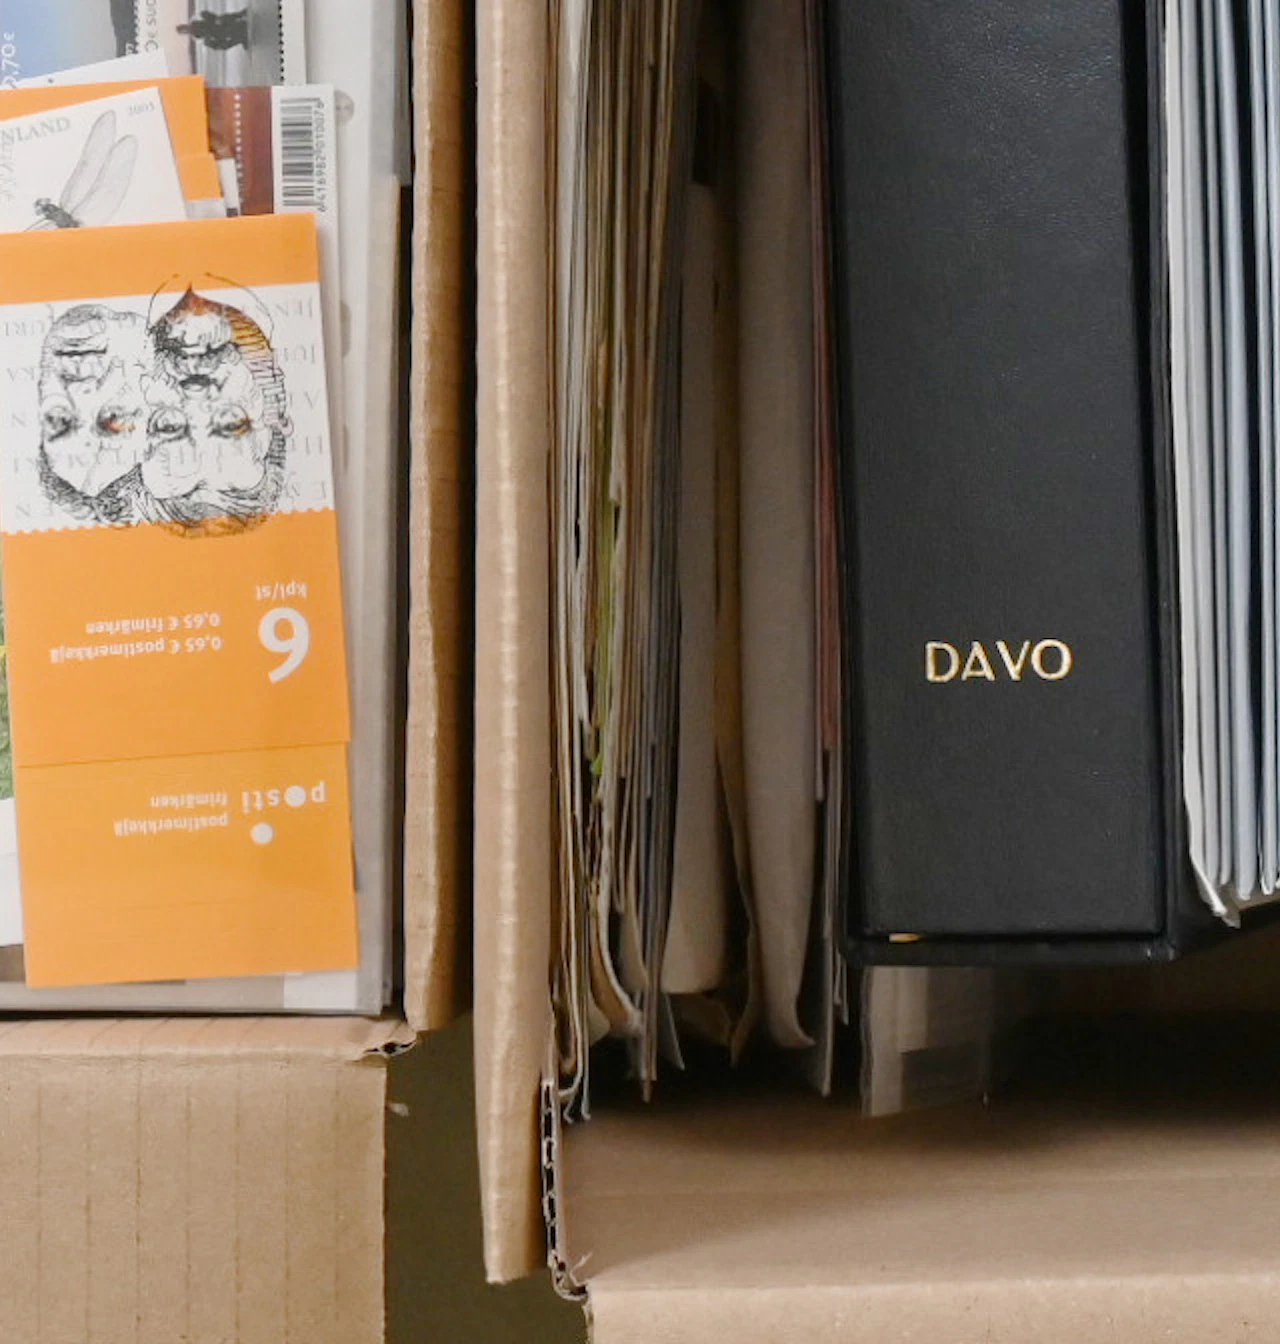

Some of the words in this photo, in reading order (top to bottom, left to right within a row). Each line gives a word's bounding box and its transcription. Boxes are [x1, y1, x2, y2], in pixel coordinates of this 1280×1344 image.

[256, 582, 307, 600] kpl/st
[86, 617, 164, 635] frimärken
[168, 615, 179, 631] €
[184, 613, 220, 629] 0,65
[49, 637, 165, 664] postimerkkejä
[169, 639, 180, 654] €
[187, 637, 223, 654] 0,65
[925, 638, 1073, 683] DAVO
[151, 791, 228, 808] frimärken
[113, 813, 228, 837] postimerkkejä
